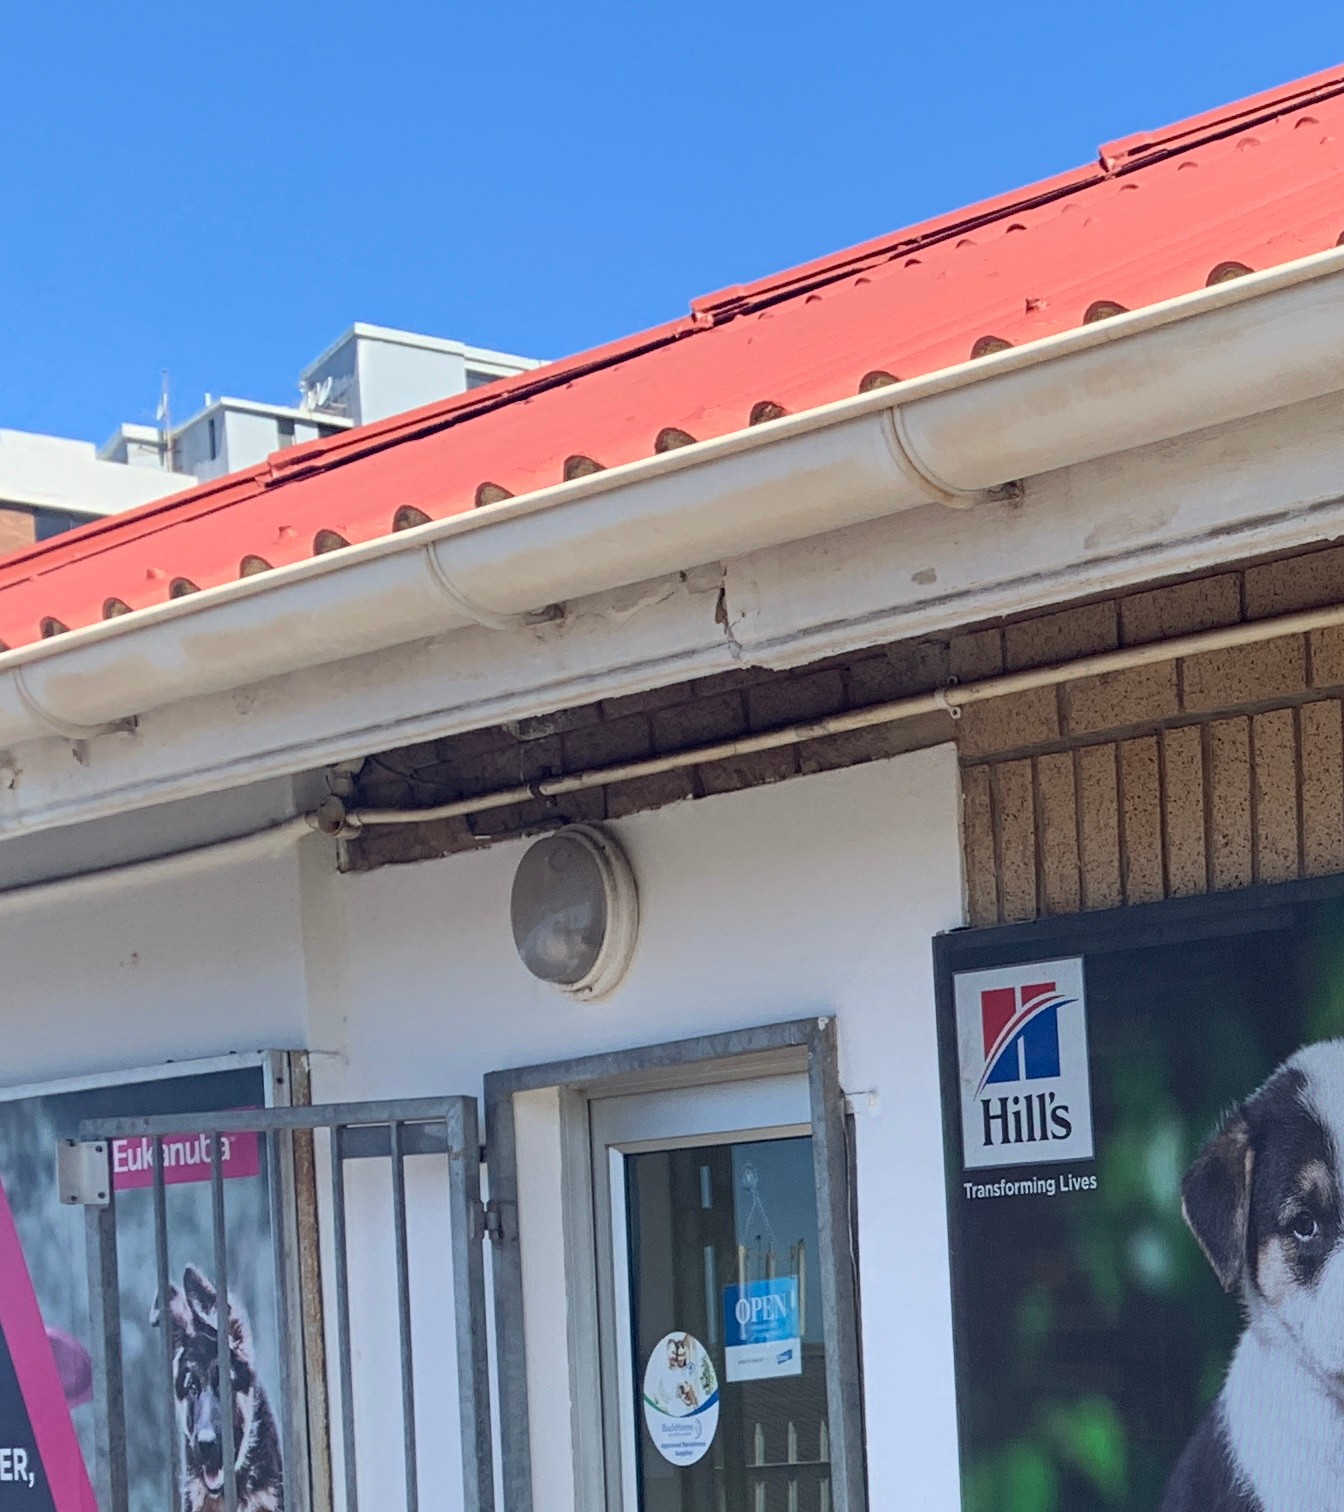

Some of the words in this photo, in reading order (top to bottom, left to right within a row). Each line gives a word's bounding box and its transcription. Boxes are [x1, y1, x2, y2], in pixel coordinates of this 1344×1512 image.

[980, 1091, 1072, 1146] Hill's
[963, 1176, 1056, 1199] Transforming
[1060, 1173, 1097, 1192] Lives
[735, 1293, 787, 1325] OPEN
